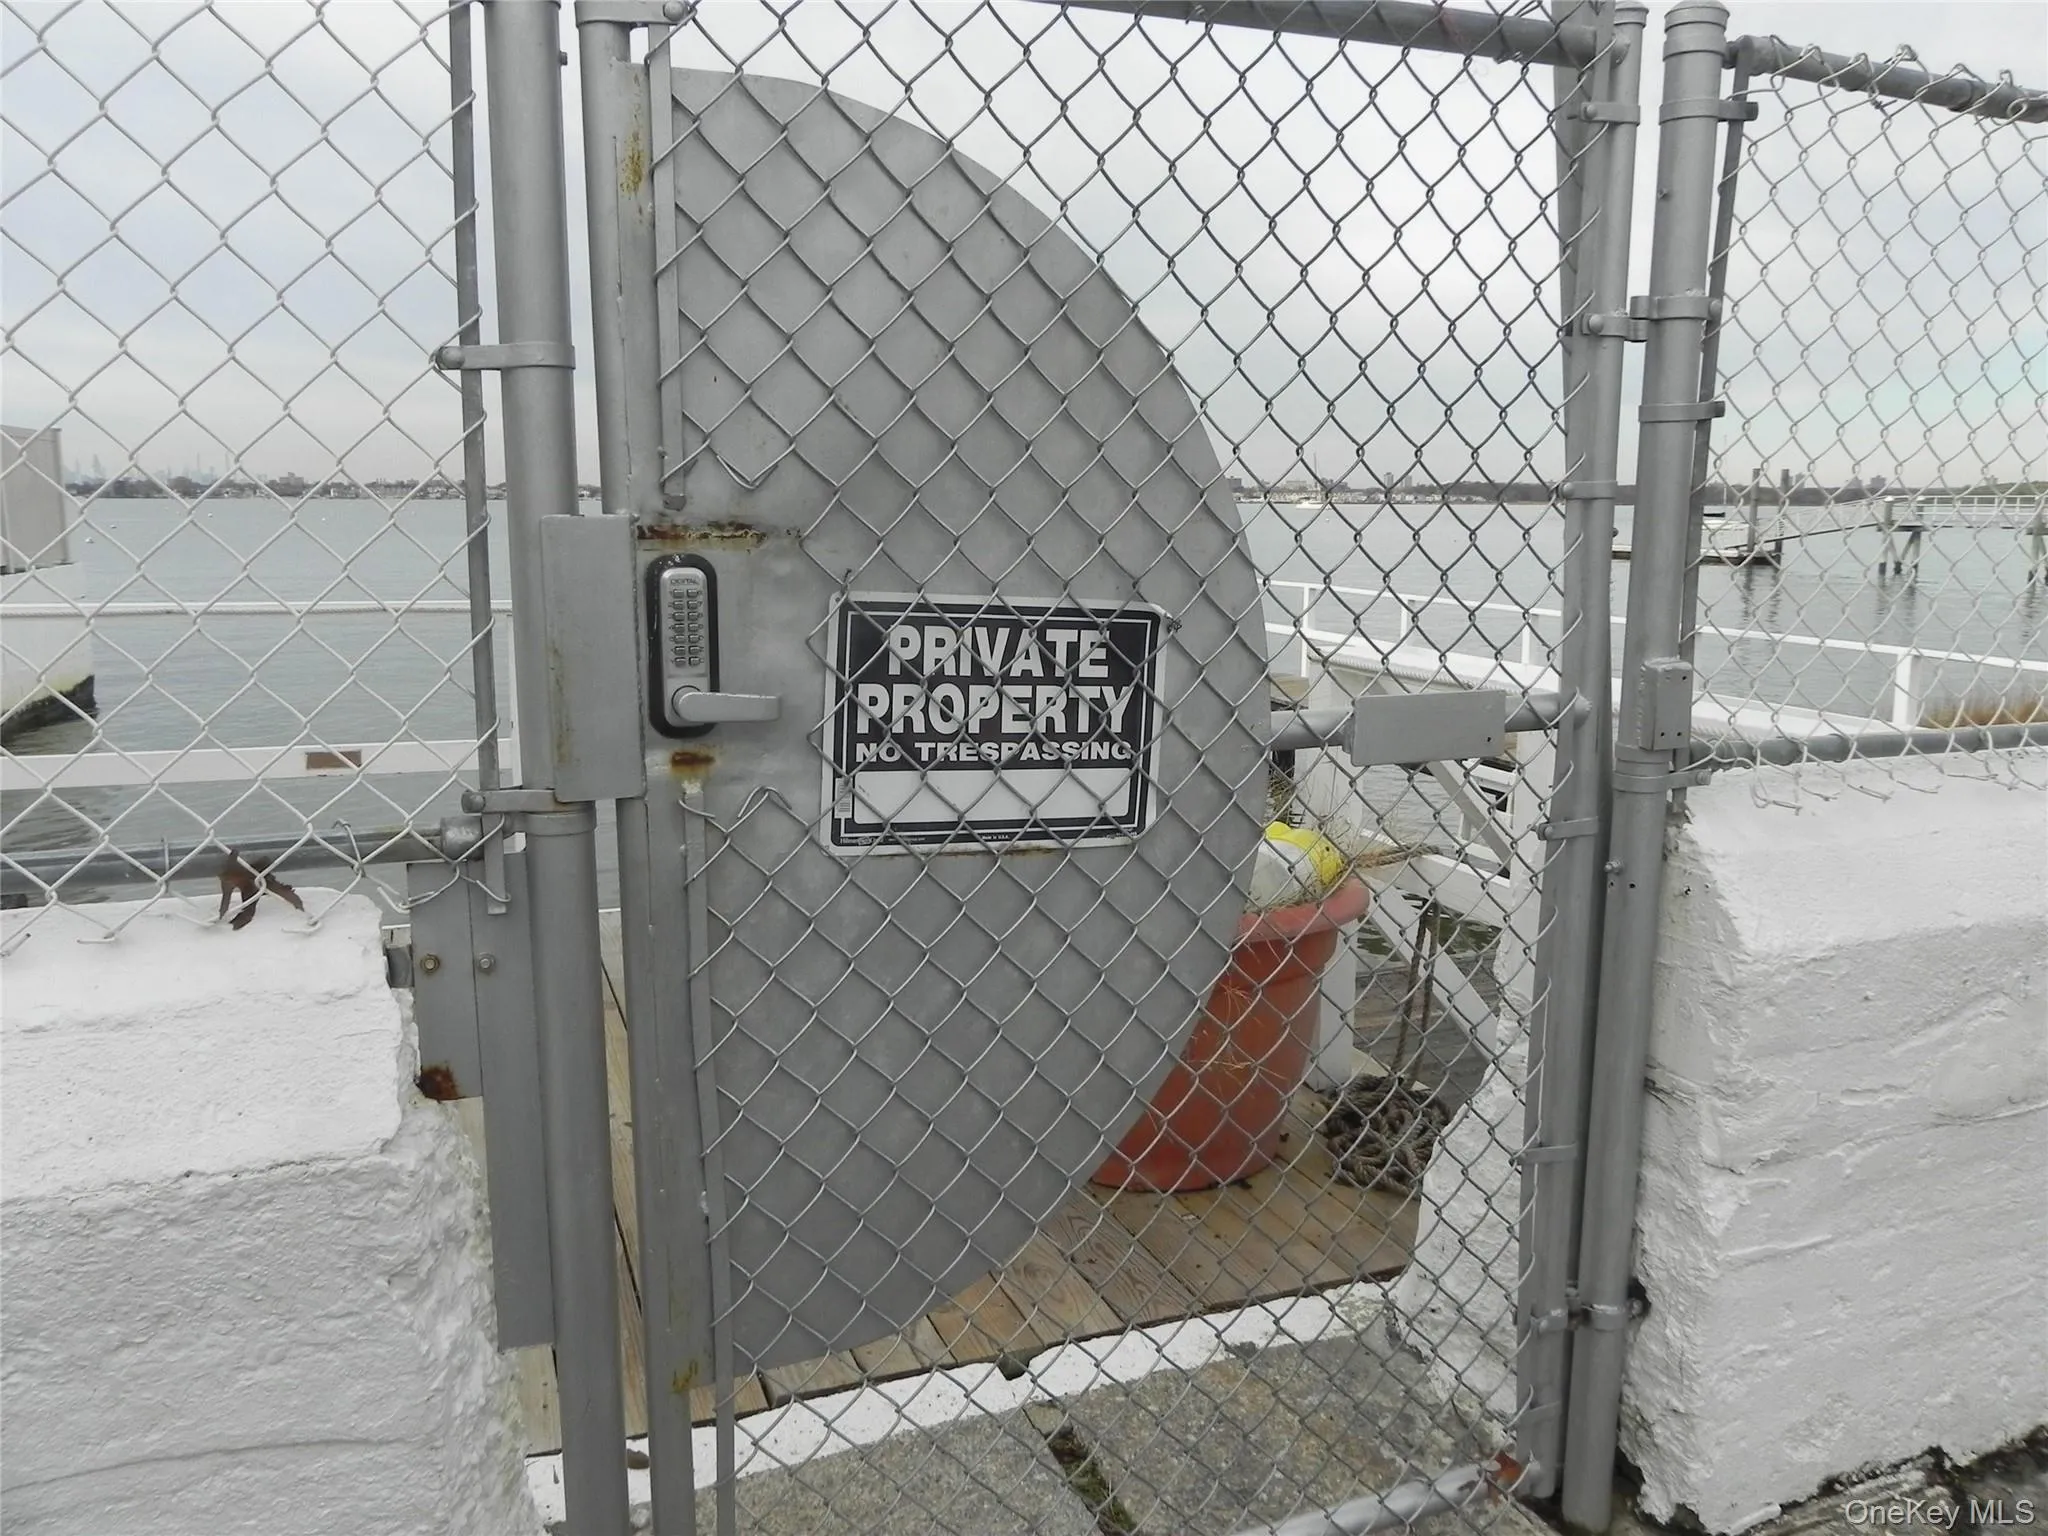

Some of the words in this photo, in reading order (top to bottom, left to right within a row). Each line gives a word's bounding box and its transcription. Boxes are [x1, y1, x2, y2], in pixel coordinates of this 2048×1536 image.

[888, 625, 1110, 678] PRIVATE
[856, 683, 1134, 735] PROPERTY
[855, 742, 902, 763] NO
[914, 741, 1132, 762] TRESPASSING
